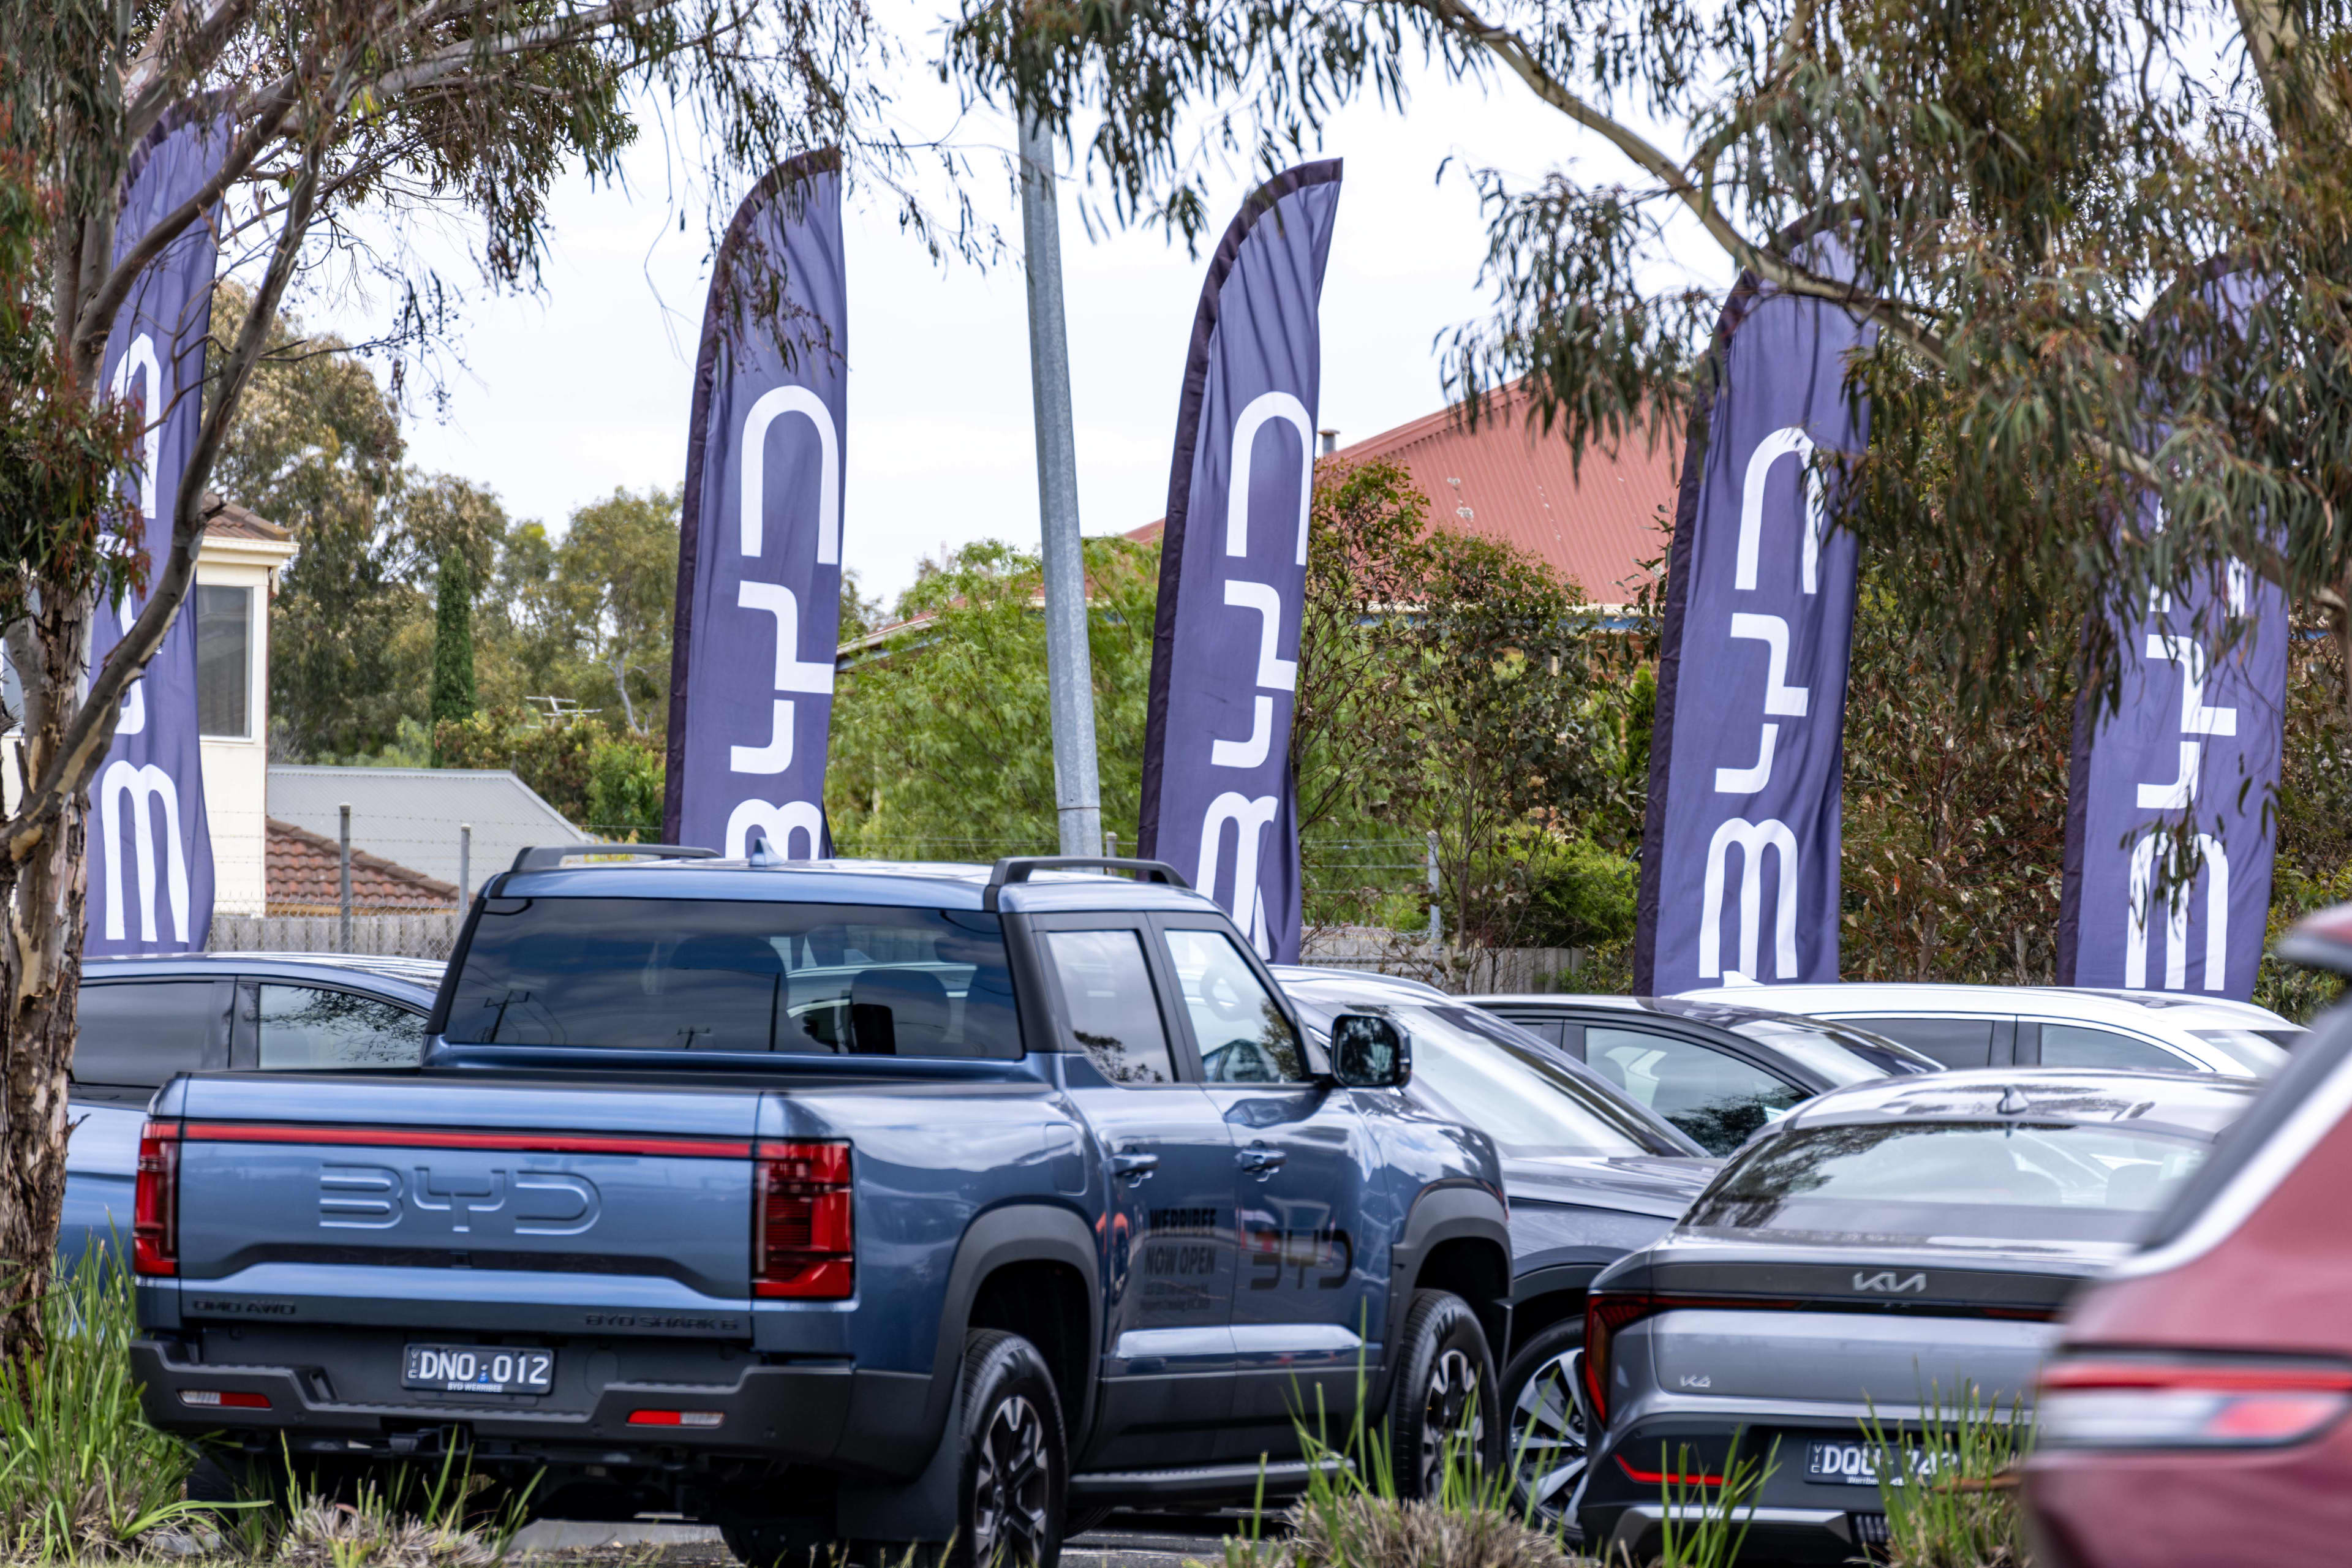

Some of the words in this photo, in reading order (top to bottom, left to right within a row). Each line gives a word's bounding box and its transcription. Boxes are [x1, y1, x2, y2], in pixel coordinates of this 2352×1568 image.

[1700, 428, 1825, 979] BYD
[318, 1162, 602, 1235] BYD
[1144, 1246, 1178, 1275] NOW
[1178, 1246, 1218, 1275] OPEN
[1250, 1227, 1354, 1291] BYD
[1853, 1271, 1926, 1292] KIA
[586, 1314, 635, 1327] BYD
[639, 1315, 716, 1330] SHARK
[419, 1351, 476, 1381] DNO
[492, 1354, 549, 1385] 012
[447, 1382, 463, 1391] BYD
[464, 1382, 503, 1392] WERRIBEE
